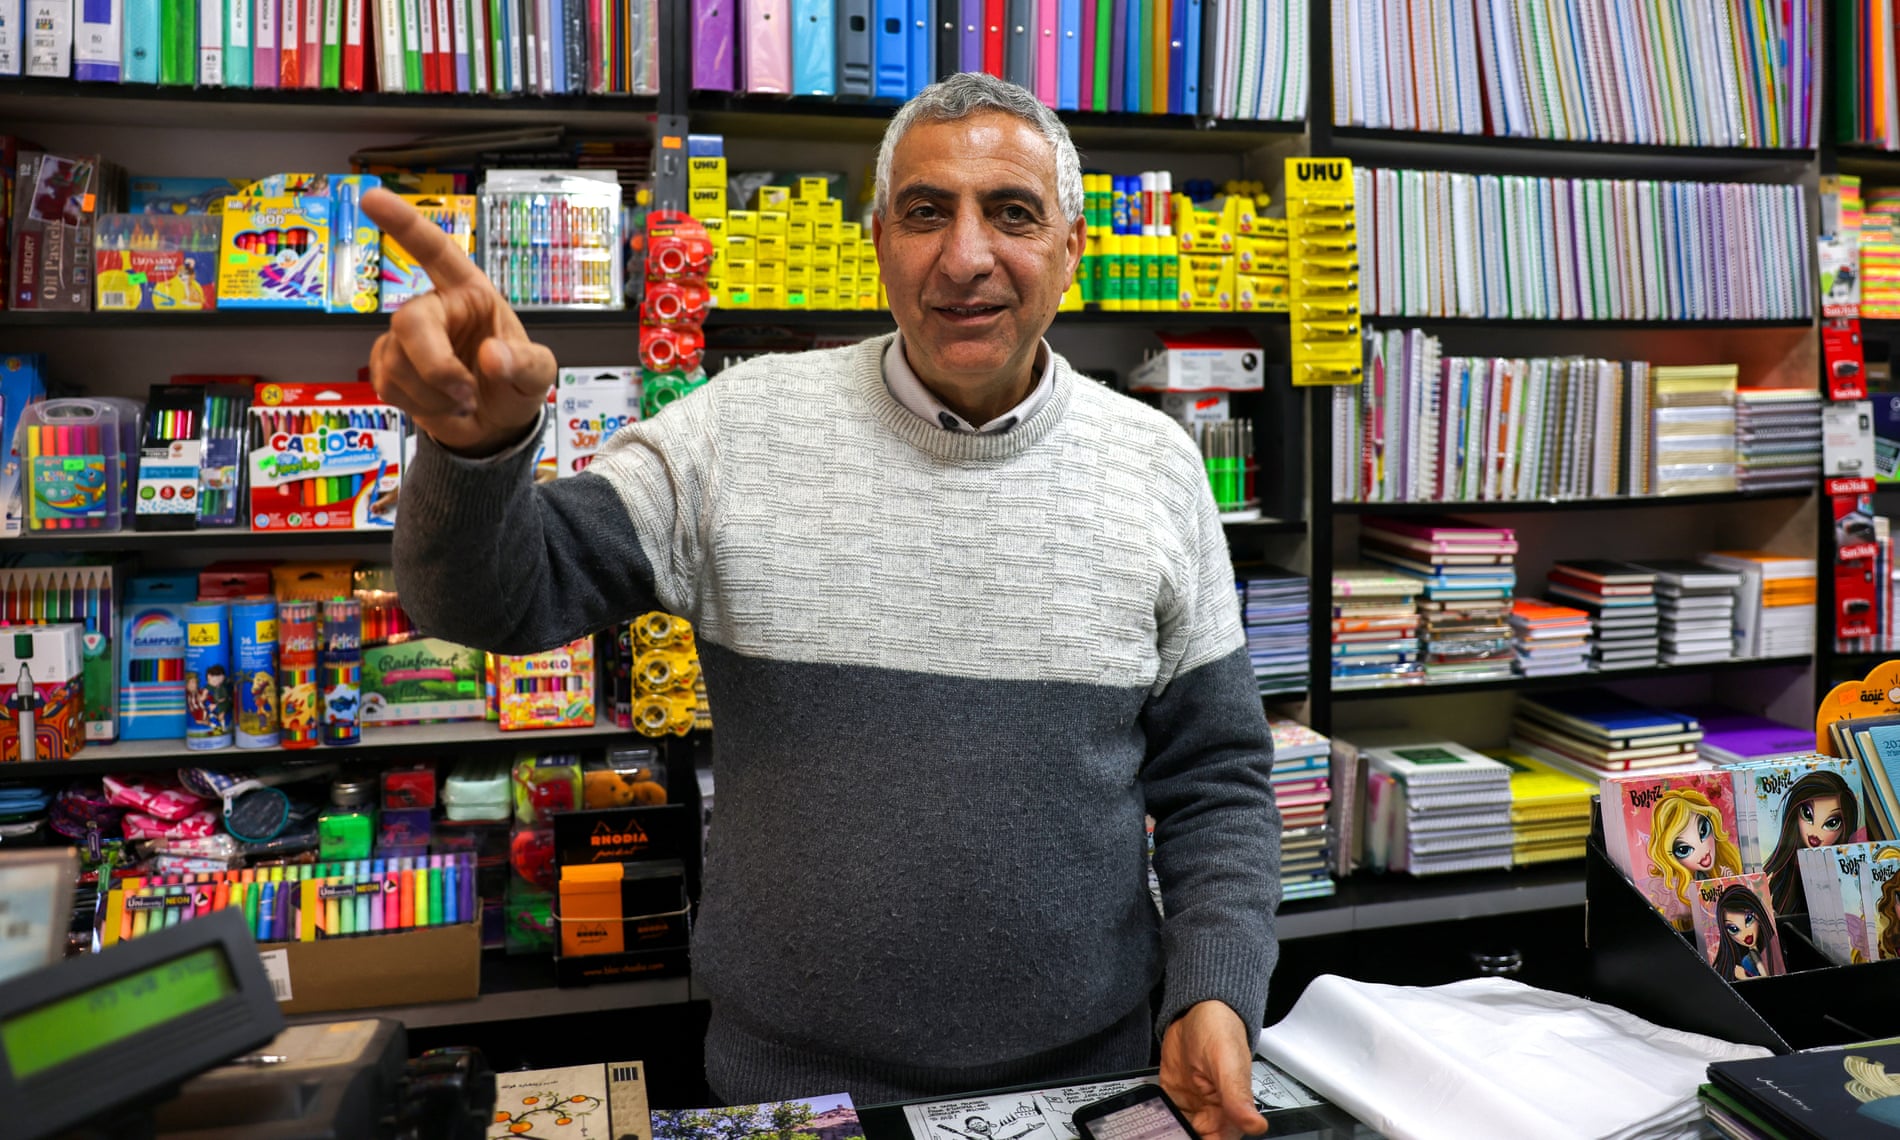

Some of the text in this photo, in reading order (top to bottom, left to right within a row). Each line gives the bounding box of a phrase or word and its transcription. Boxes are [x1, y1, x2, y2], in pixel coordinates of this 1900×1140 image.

[693, 160, 719, 169] UHU
[1297, 163, 1342, 181] UHU
[693, 191, 719, 200] UHU
[22, 235, 34, 284] MEMORY
[44, 218, 61, 299] Oil Pastels
[265, 391, 279, 400] 24
[1831, 481, 1868, 493] SanDisk
[1840, 545, 1876, 560] SanDisk
[133, 636, 181, 647] CAMPUS
[379, 650, 459, 671] Rainforest
[526, 659, 568, 670] ANGELO
[590, 832, 648, 846] RHODIA
[355, 883, 380, 894] NEON
[165, 895, 191, 906] NEON
